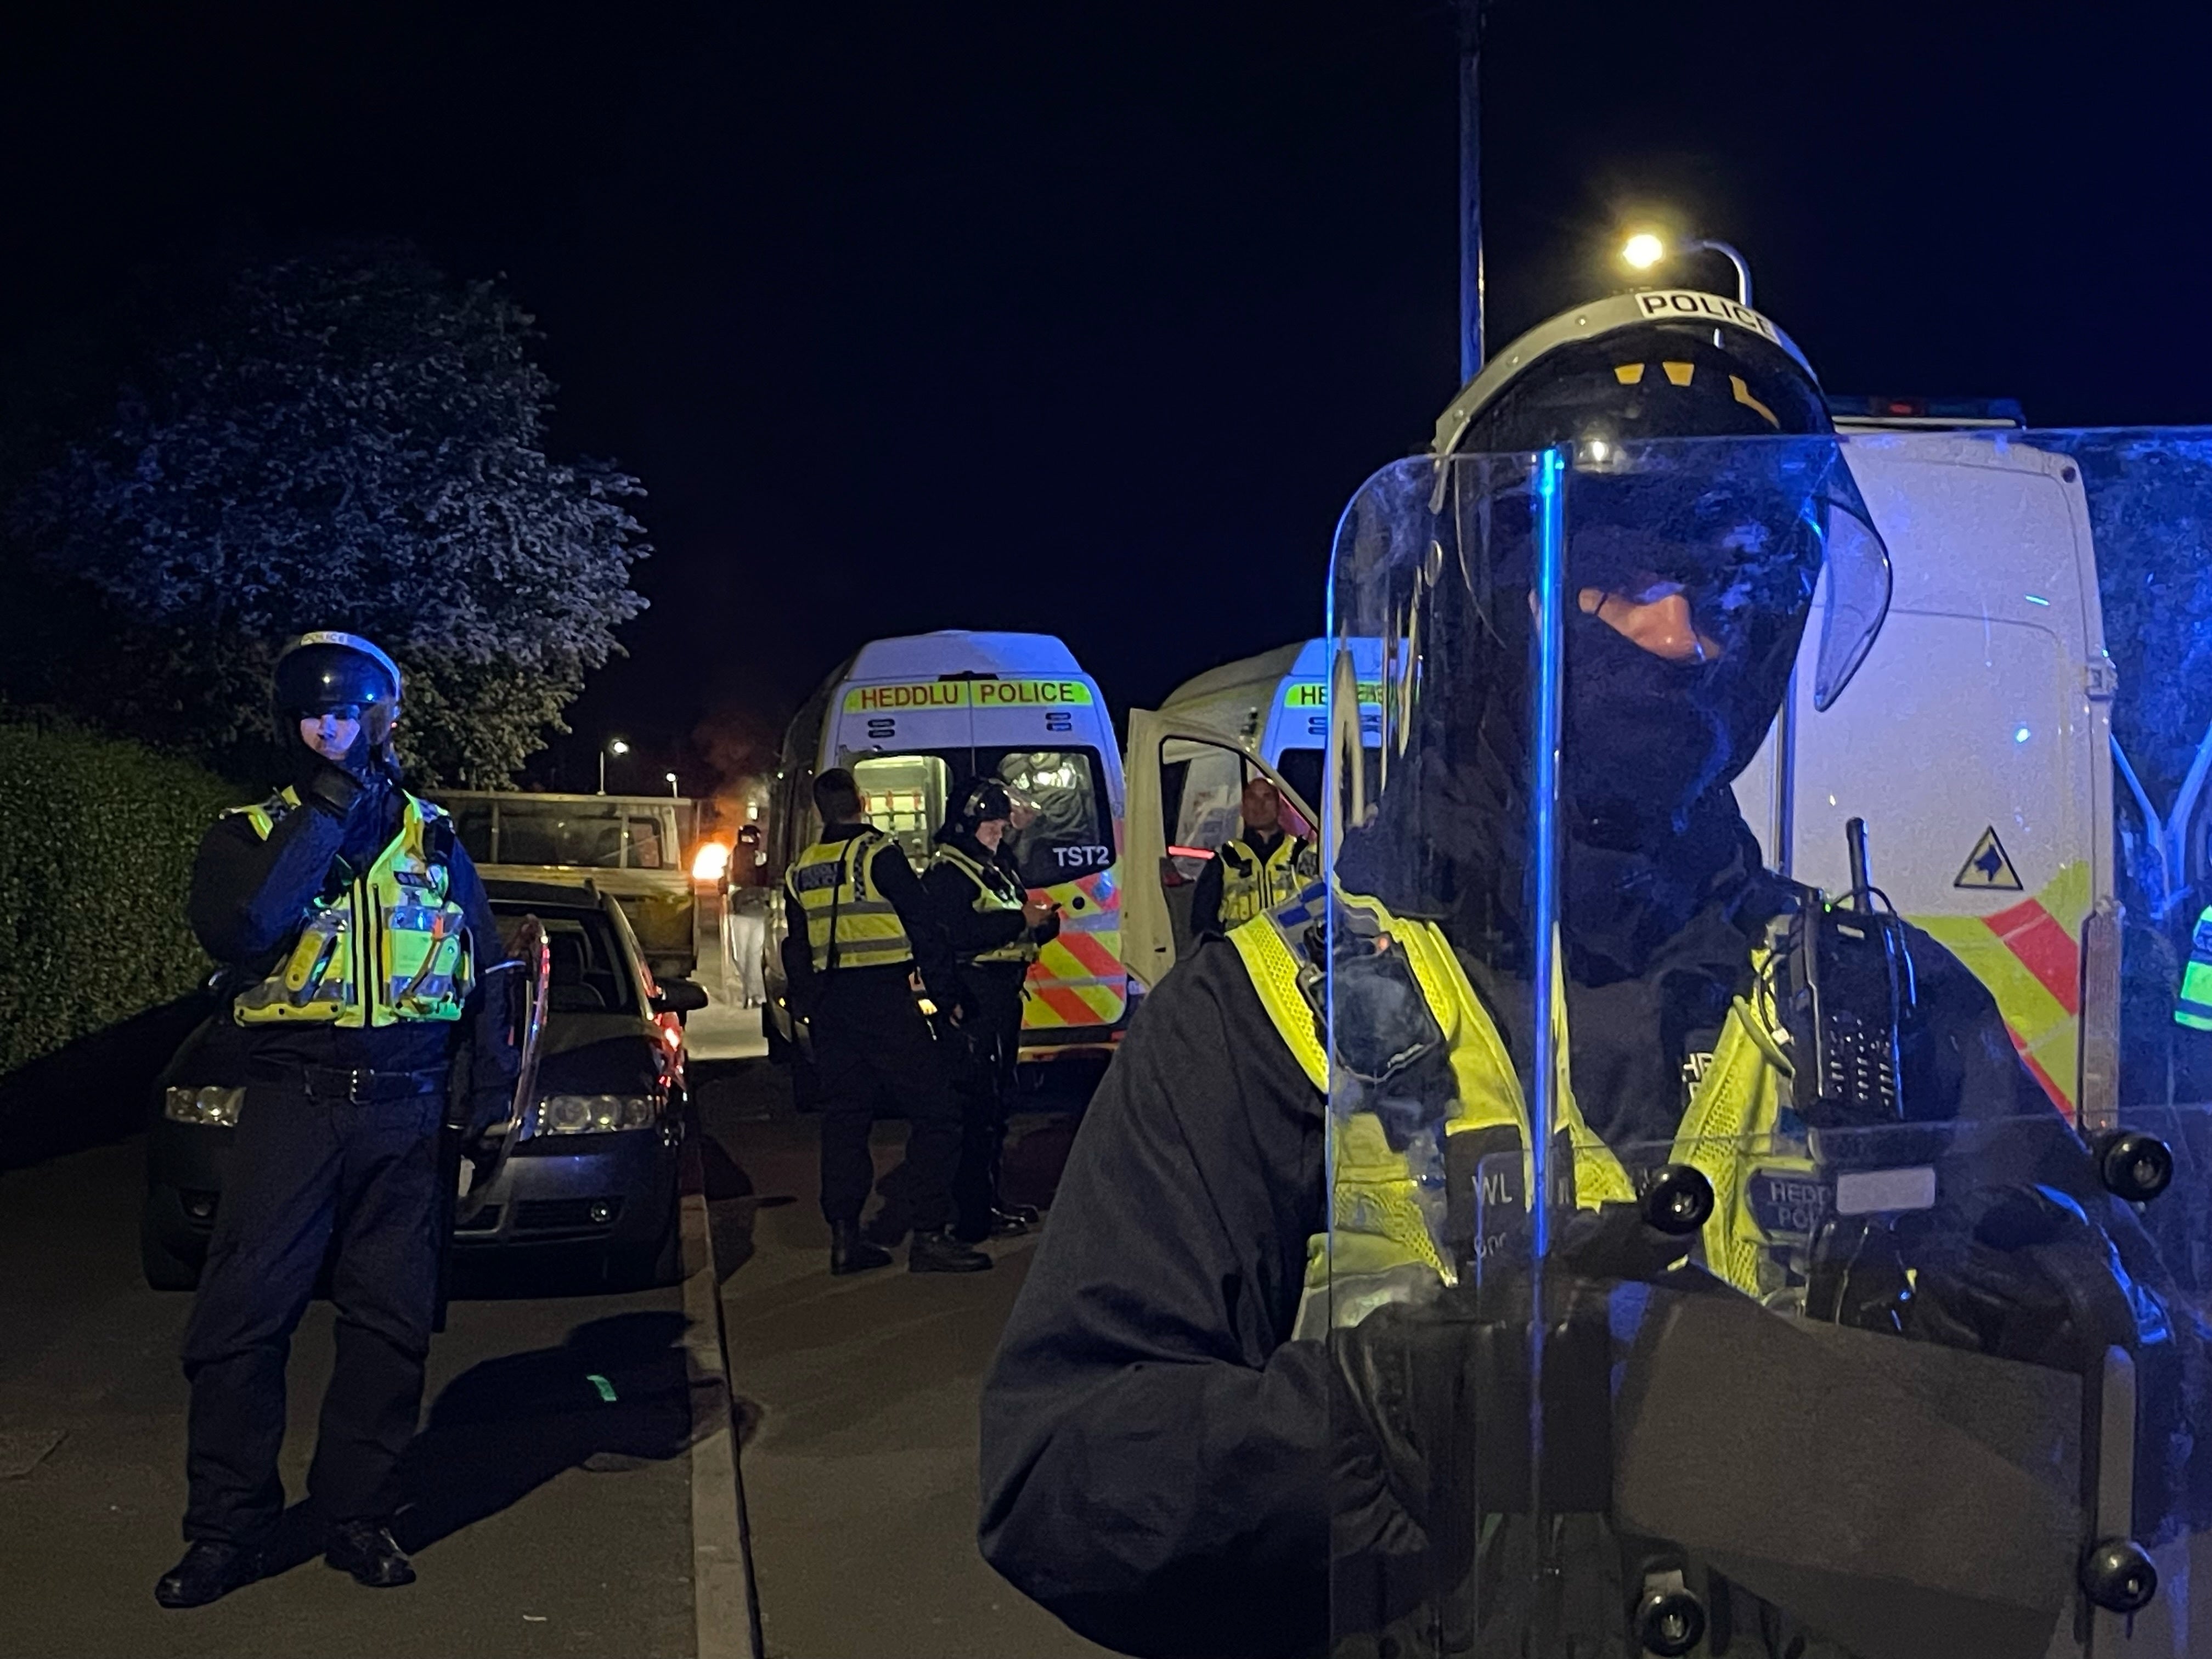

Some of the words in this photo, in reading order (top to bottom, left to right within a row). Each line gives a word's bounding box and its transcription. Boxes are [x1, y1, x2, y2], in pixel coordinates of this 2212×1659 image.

[1642, 295, 1776, 339] POLICE
[861, 684, 958, 709] HEDDLU
[980, 682, 1075, 703] POLICE
[1052, 845, 1110, 866] TST2
